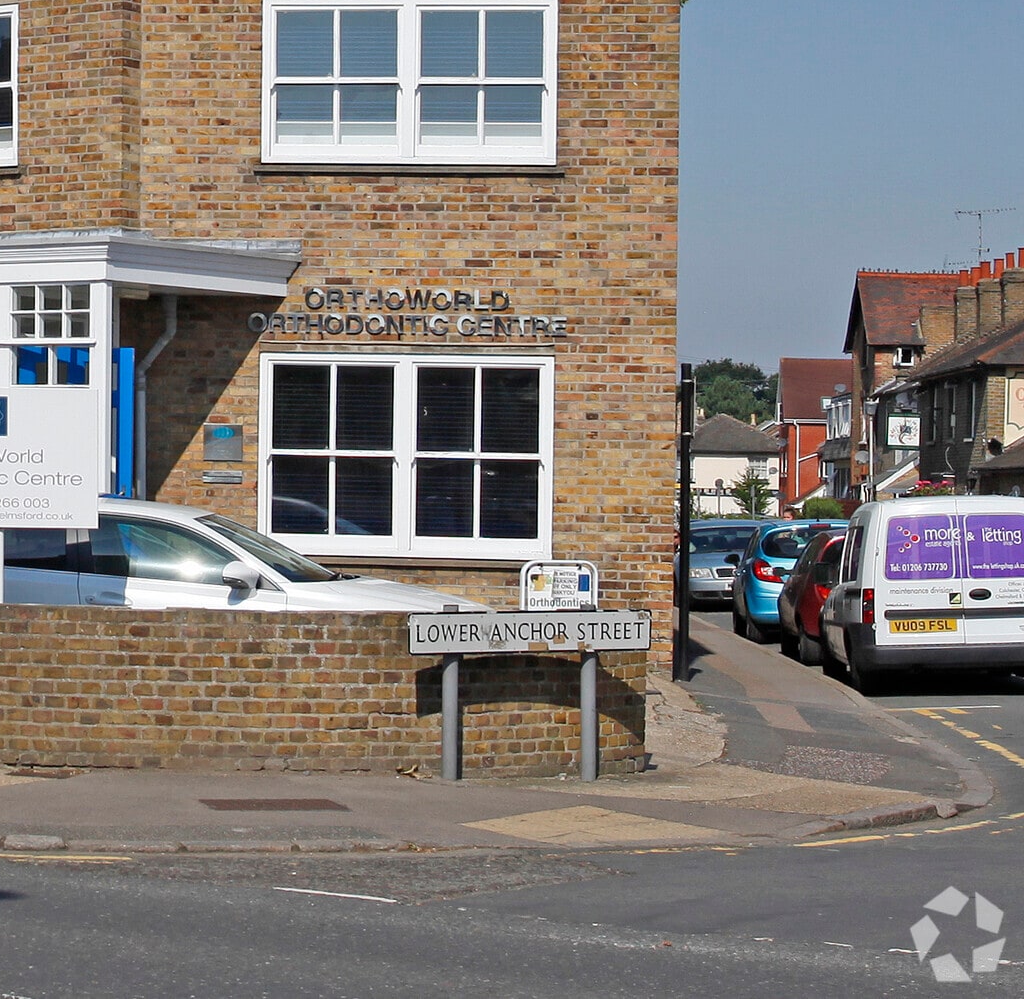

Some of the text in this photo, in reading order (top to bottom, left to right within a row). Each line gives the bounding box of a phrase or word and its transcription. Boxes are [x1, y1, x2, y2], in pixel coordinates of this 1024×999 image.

[305, 287, 511, 311] ORTHOWORLD
[248, 313, 568, 338] ORTHODONTIC CENTRE
[14, 470, 83, 487] Centre
[23, 497, 50, 509] 003
[925, 528, 961, 540] more
[967, 531, 975, 541] &
[982, 527, 1022, 544] letting
[890, 563, 901, 571] Tel:
[924, 563, 948, 571] 737730
[415, 622, 645, 643] LOWER ANCHOR STREET
[929, 620, 953, 630] FSL
